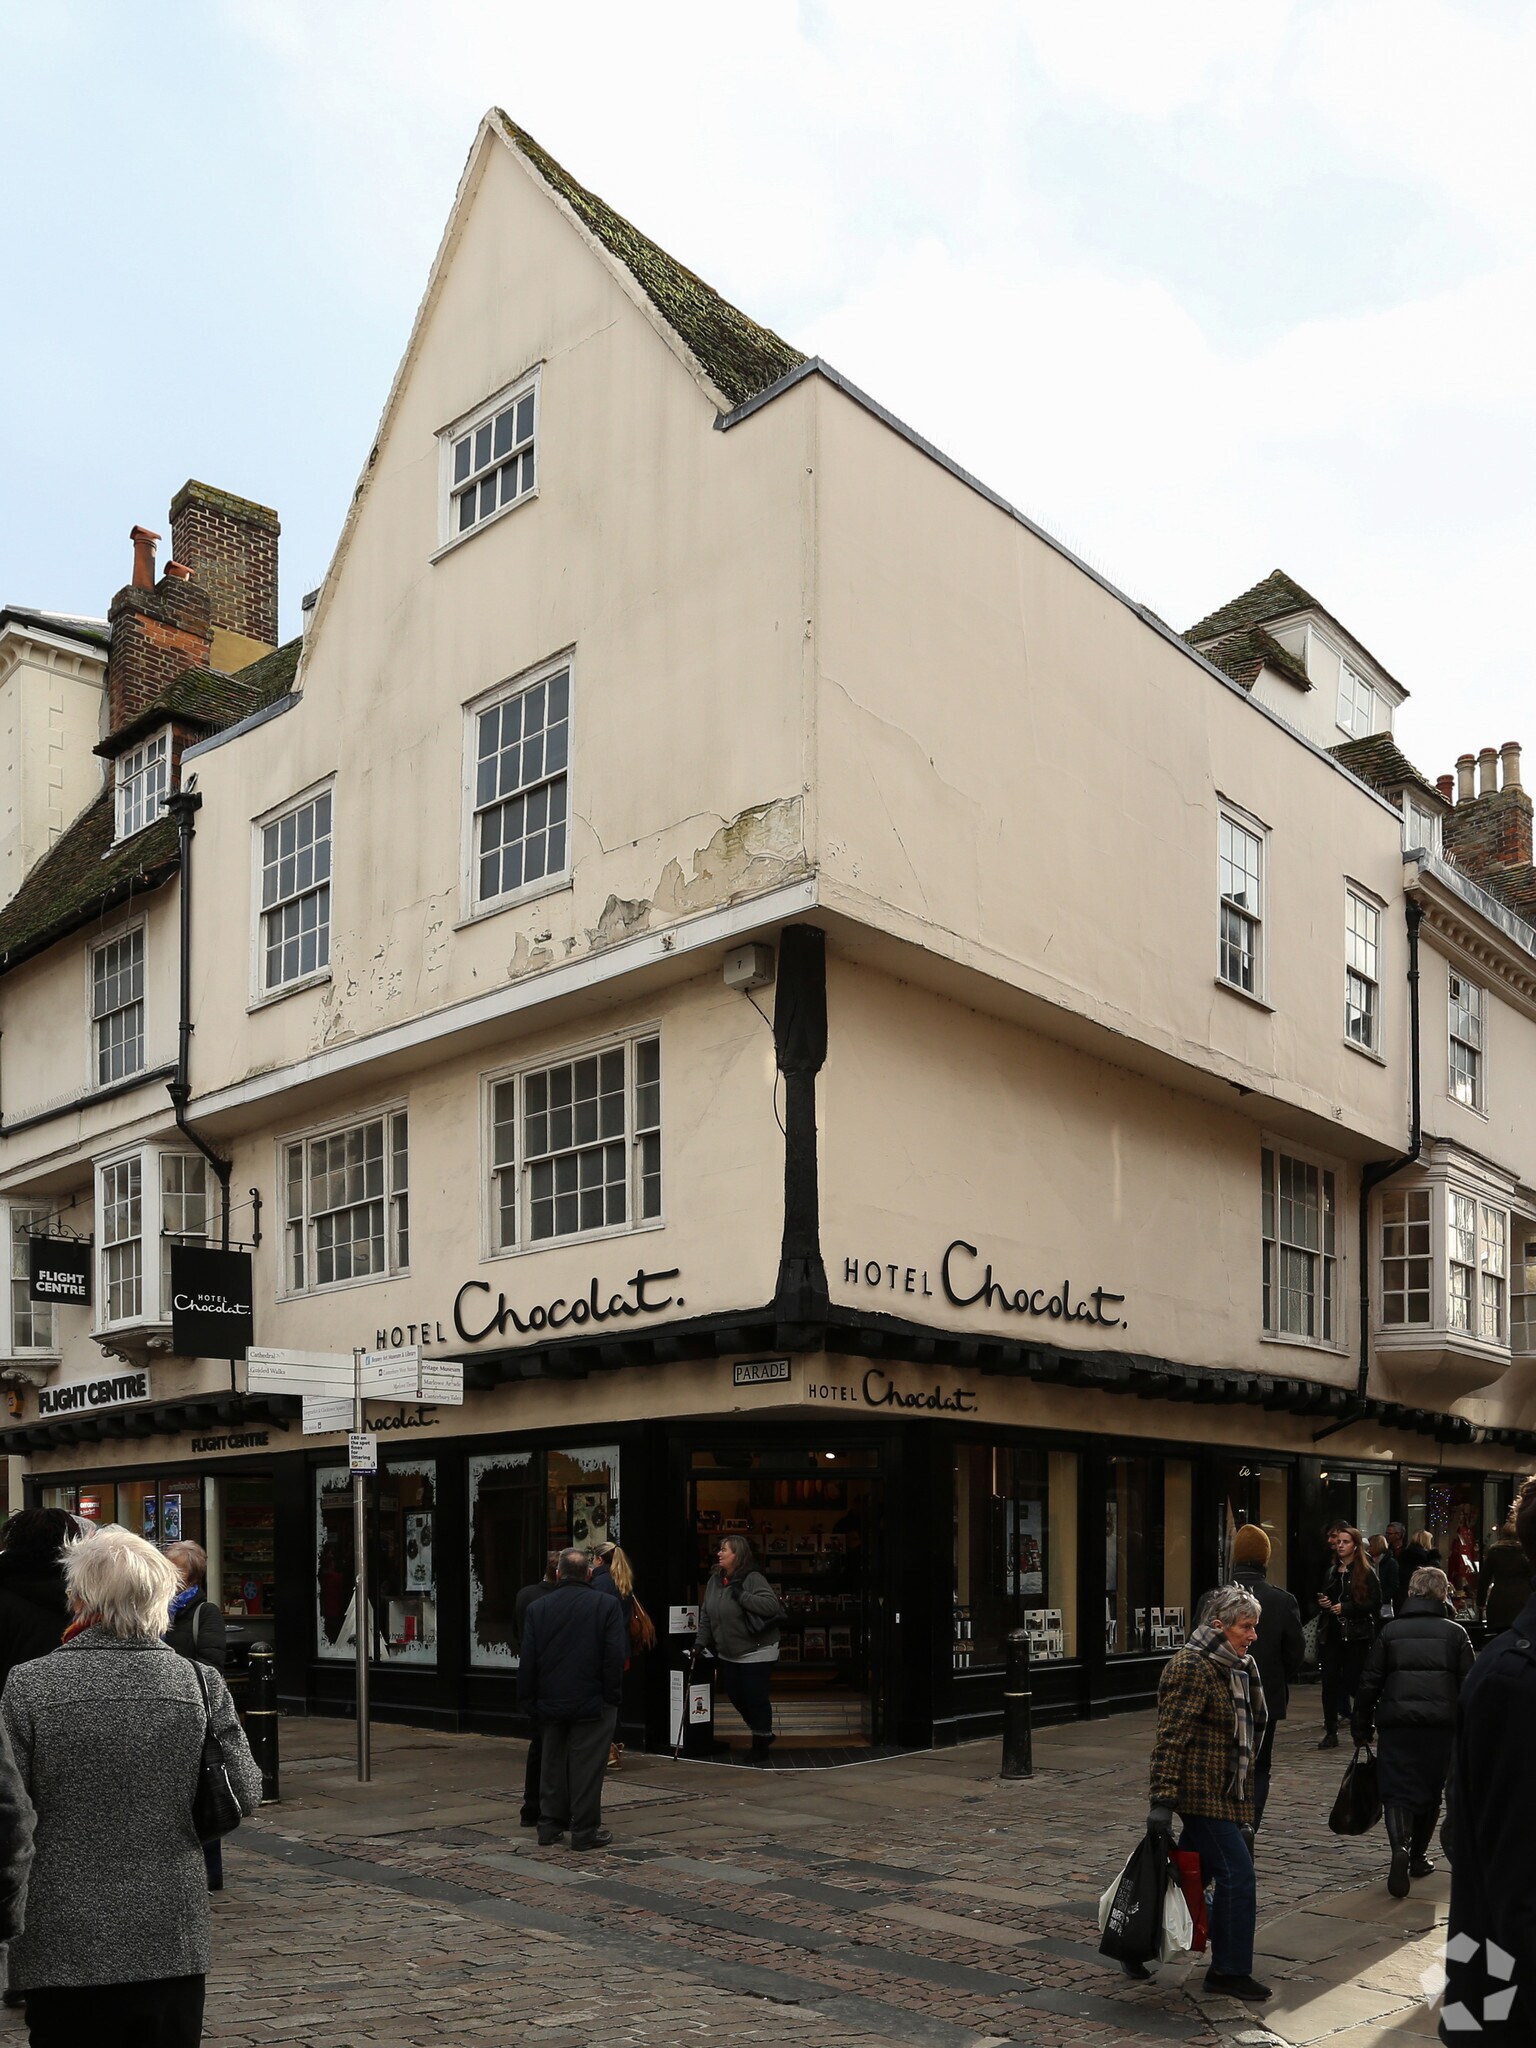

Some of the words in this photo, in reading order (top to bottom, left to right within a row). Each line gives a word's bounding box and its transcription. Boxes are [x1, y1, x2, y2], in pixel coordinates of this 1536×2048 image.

[38, 1270, 85, 1284] FLIGHT
[844, 1257, 933, 1296] HOTEL
[942, 1240, 1128, 1329] Chocolat.
[36, 1282, 86, 1296] CENTRE
[174, 1294, 252, 1316] Chocolat.
[197, 1294, 228, 1303] HOTEL
[376, 1321, 447, 1349] HOTEL
[453, 1268, 685, 1343] Chocolat.
[250, 1351, 276, 1359] Cathedral
[440, 1365, 461, 1373] Museum
[736, 1363, 786, 1381] PARADE
[39, 1384, 88, 1414] FLIGHT
[88, 1373, 147, 1404] CENTRE
[424, 1392, 450, 1401] Canterbury
[809, 1384, 858, 1401] HOTEL
[862, 1368, 978, 1413] Chocolat.
[191, 1435, 228, 1453] FLIGHT
[228, 1431, 269, 1449] CENTRE
